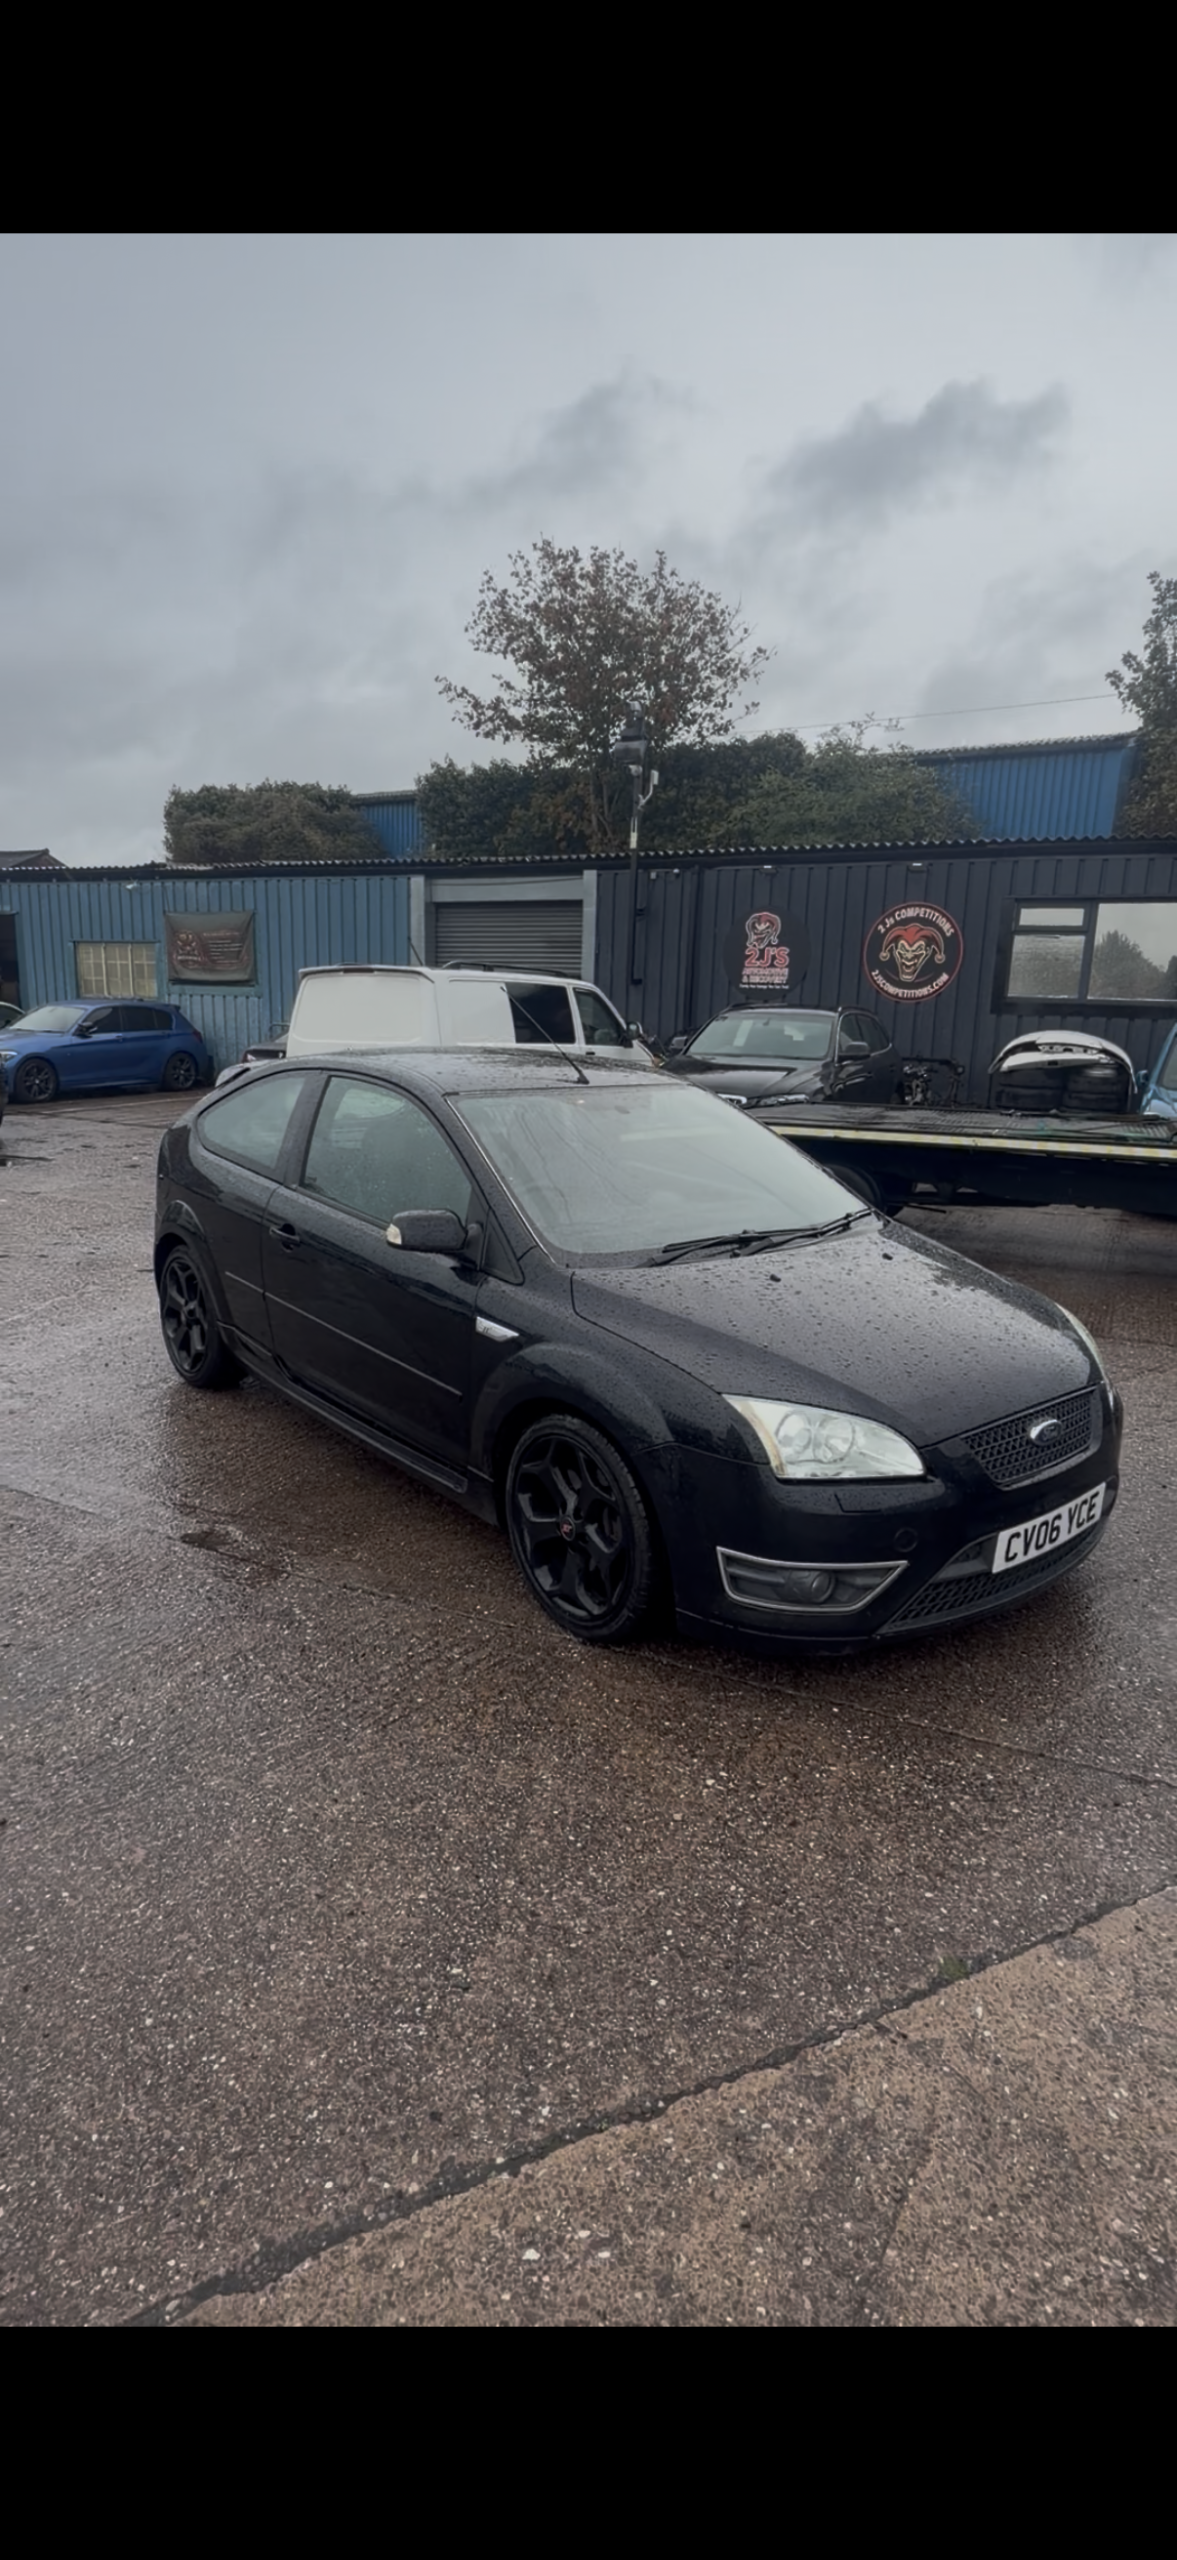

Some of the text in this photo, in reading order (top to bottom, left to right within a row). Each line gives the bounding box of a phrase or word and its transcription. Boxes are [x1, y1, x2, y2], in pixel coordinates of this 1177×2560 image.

[877, 924, 886, 934] 2
[894, 906, 955, 937] COMPETITIONS
[1004, 1490, 1100, 1563] CV06 YCE
